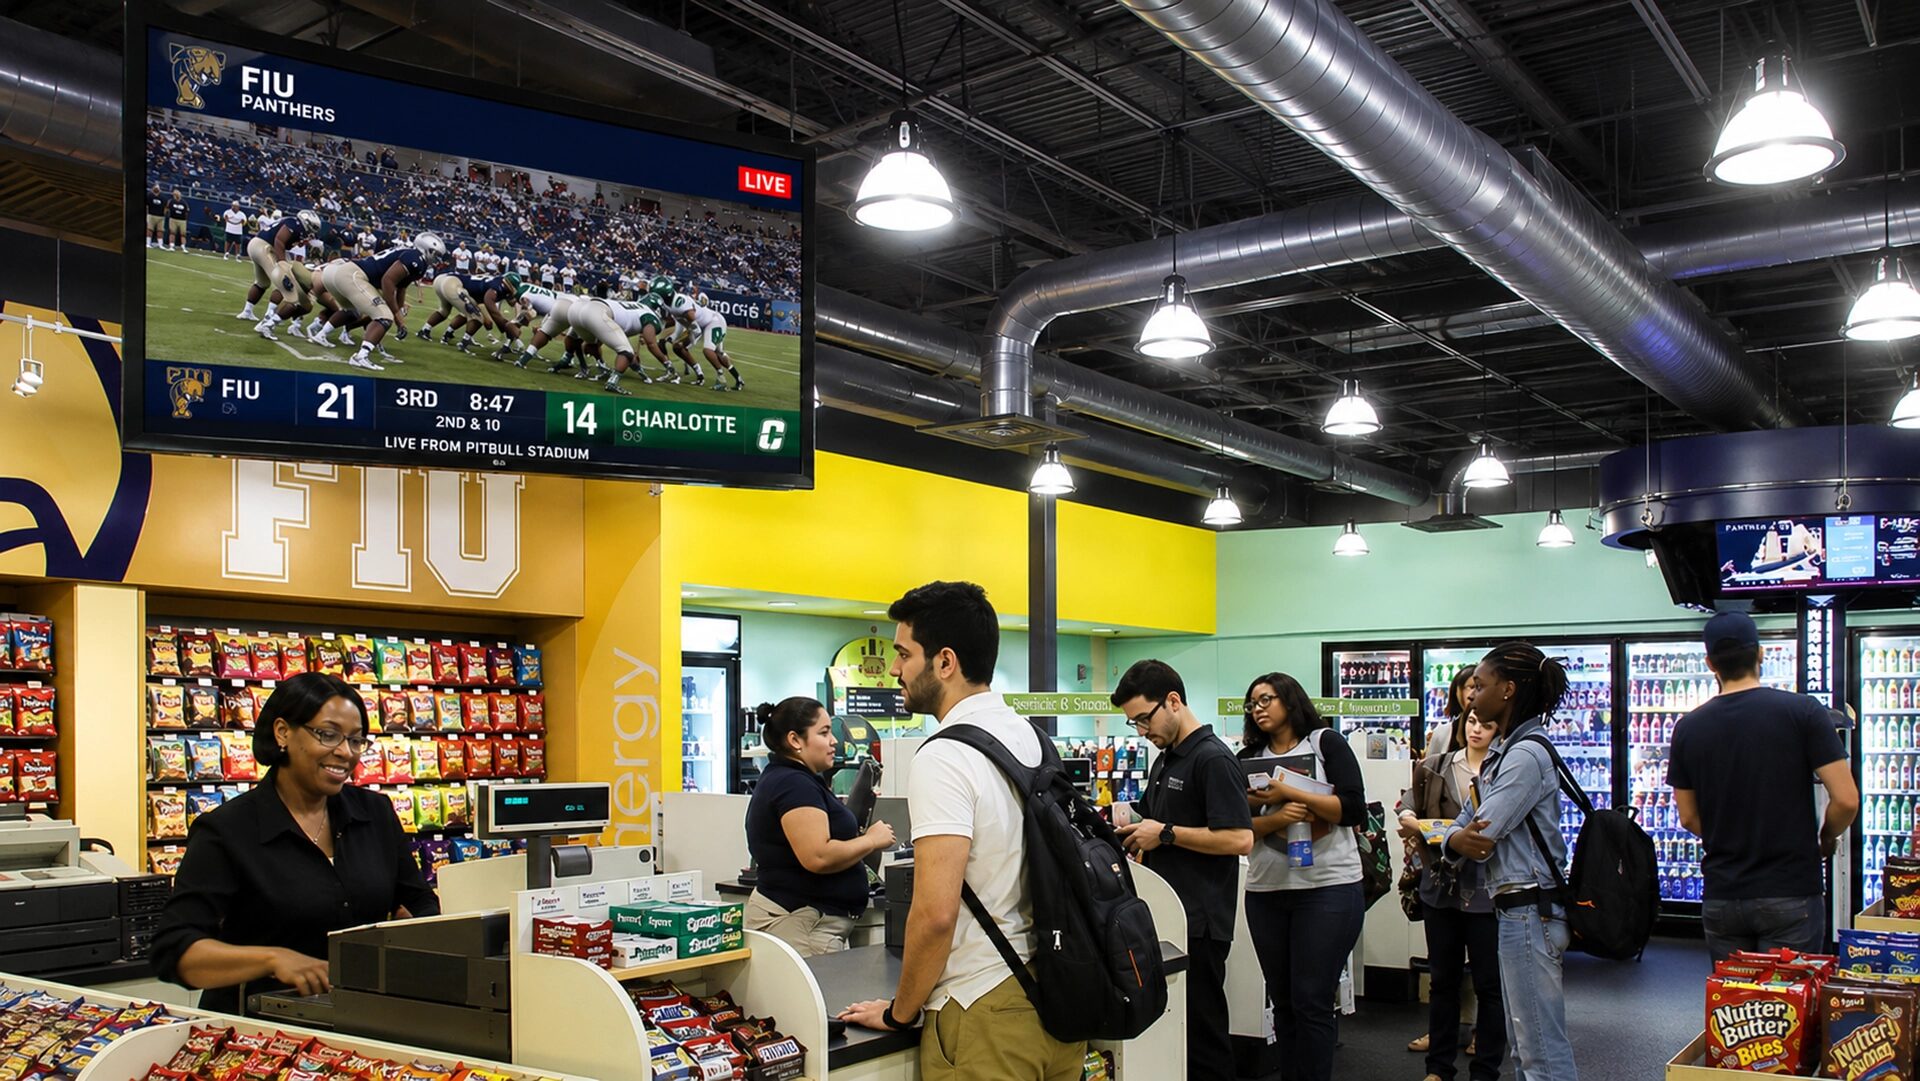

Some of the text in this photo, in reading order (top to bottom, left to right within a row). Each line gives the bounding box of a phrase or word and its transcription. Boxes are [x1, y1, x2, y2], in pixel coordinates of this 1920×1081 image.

[241, 65, 294, 98] FIU
[241, 94, 335, 123] PANTHERS
[744, 171, 786, 193] LIVE
[221, 378, 260, 400] FIU
[317, 382, 354, 420] 21
[395, 387, 515, 413] 3RD 8:47
[435, 415, 501, 432] 2ND & 10
[562, 400, 598, 435] 14
[622, 408, 737, 434] CHARLOTTE
[384, 436, 590, 460] LIVE FROM PITBULL STADIUM
[222, 459, 526, 599] FIU
[1715, 1001, 1786, 1029] Nutter
[1722, 1018, 1788, 1047] Butter
[1736, 1039, 1784, 1067] Bites
